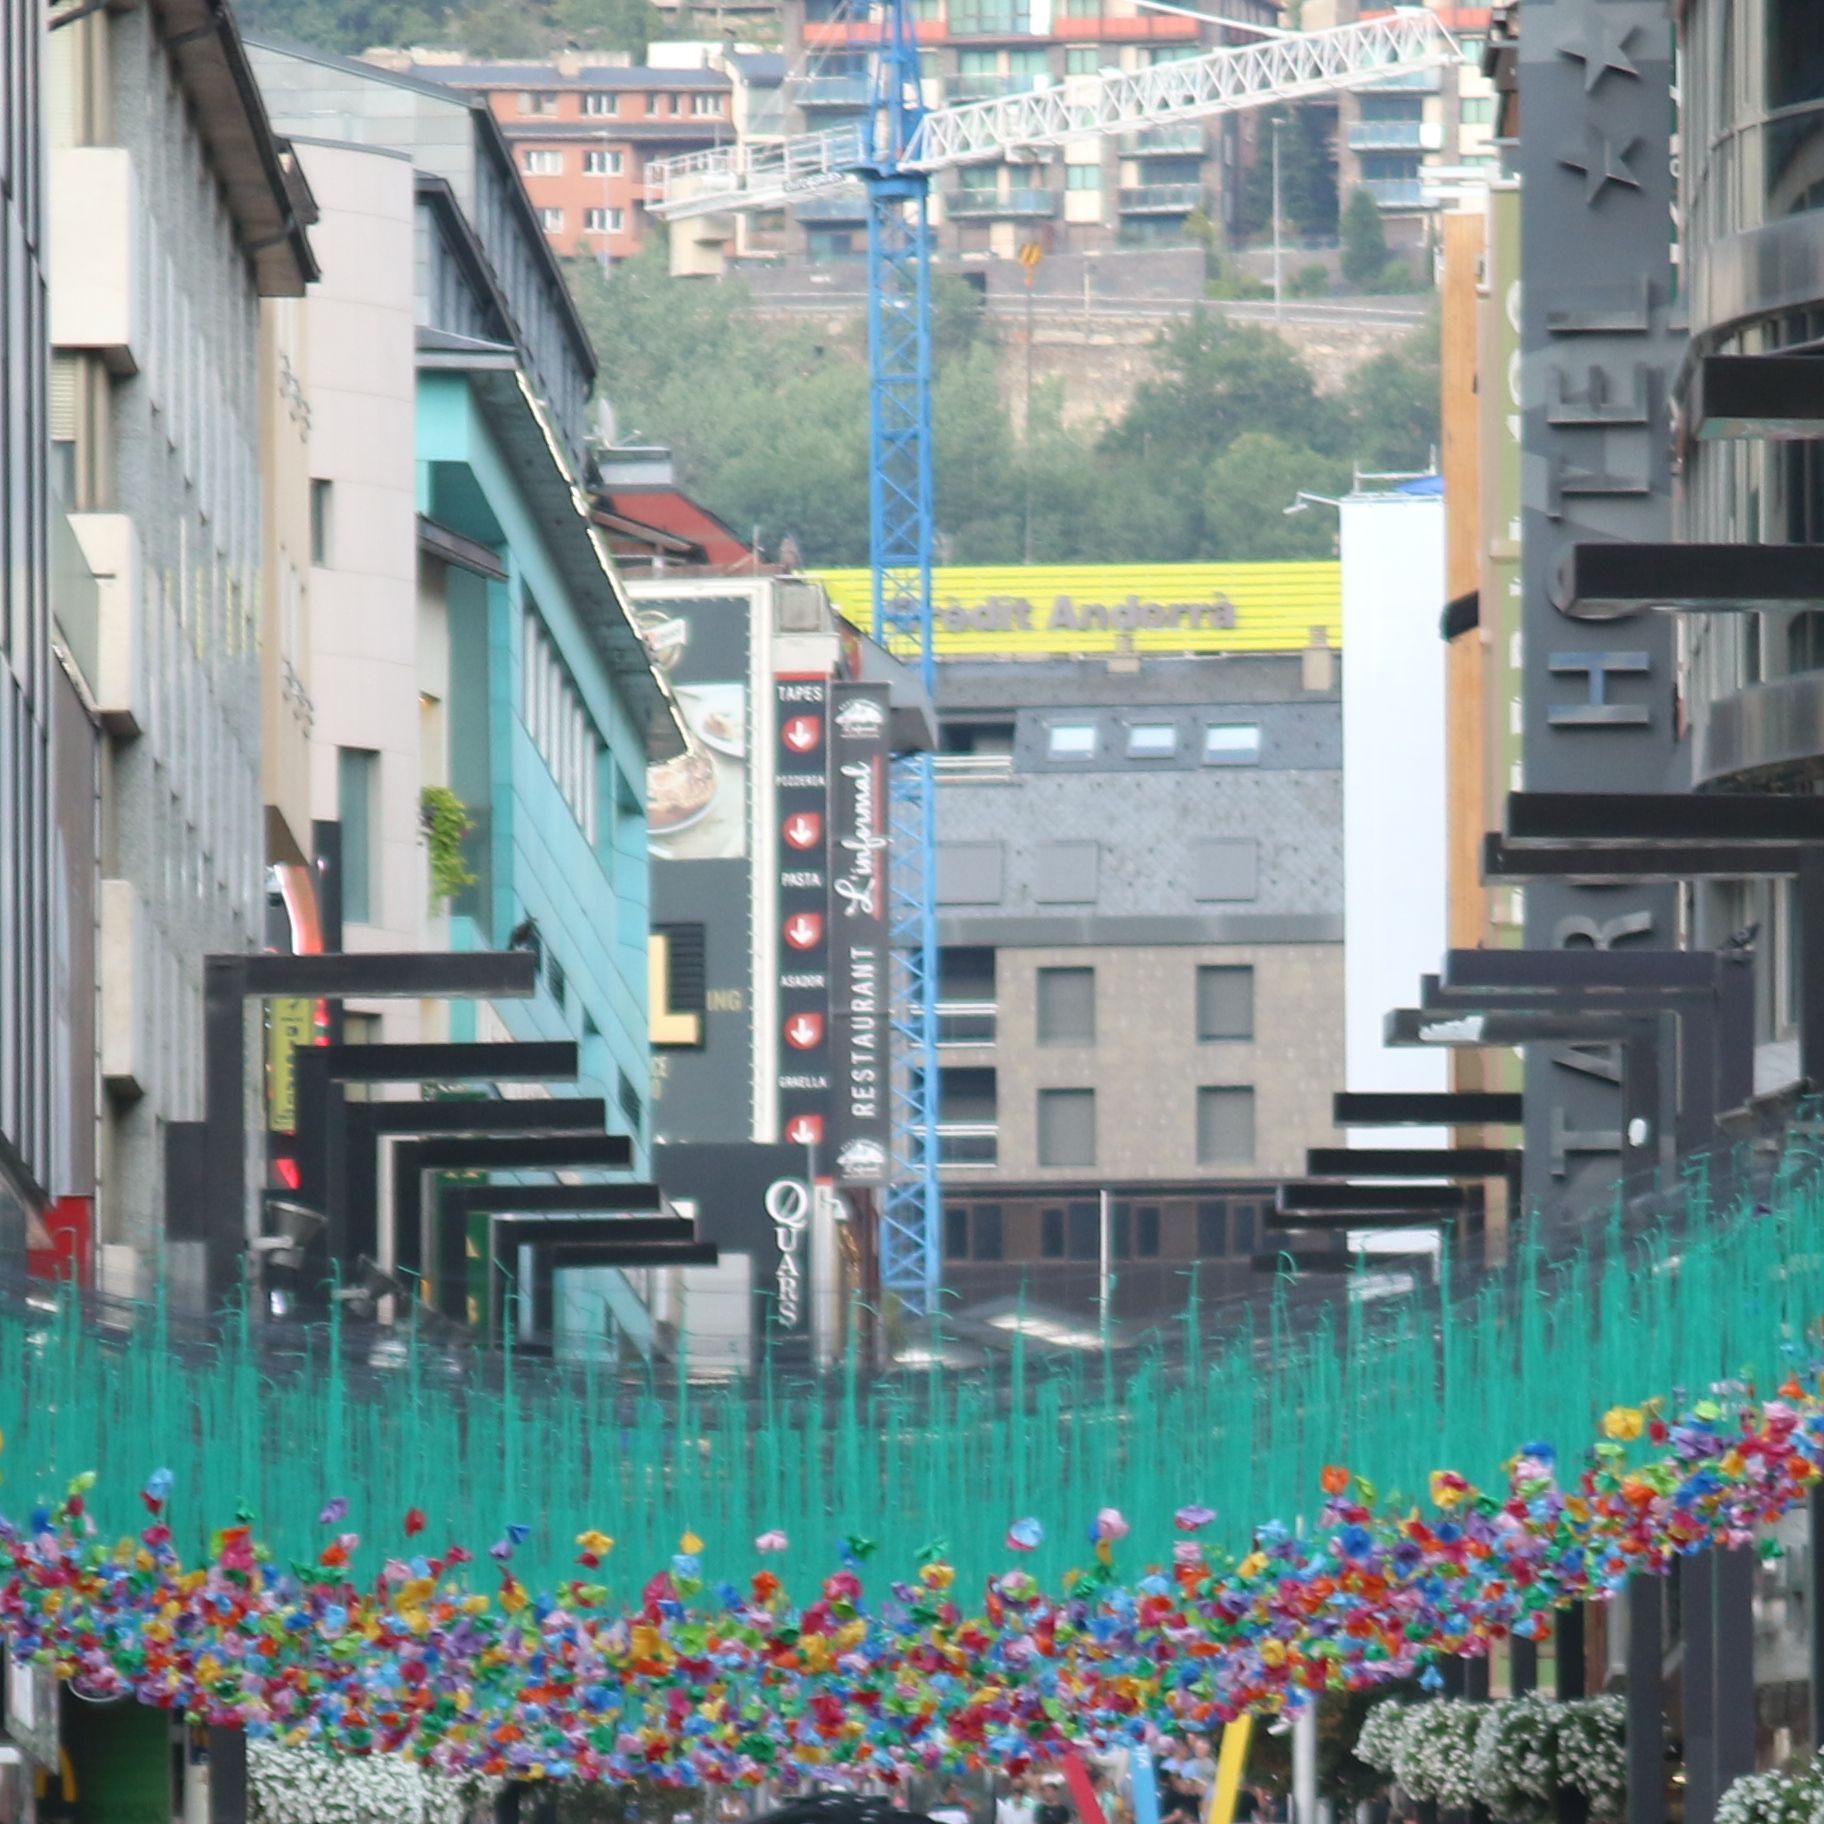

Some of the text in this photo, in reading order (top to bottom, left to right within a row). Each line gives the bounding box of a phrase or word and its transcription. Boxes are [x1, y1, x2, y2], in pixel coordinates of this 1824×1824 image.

[1048, 591, 1237, 630] Andorrà
[777, 686, 823, 702] TAPES
[781, 872, 822, 887] PASTA
[780, 975, 825, 988] ASADOR
[850, 945, 875, 1119] RESTAURANT
[764, 1180, 809, 1329] QUARS
